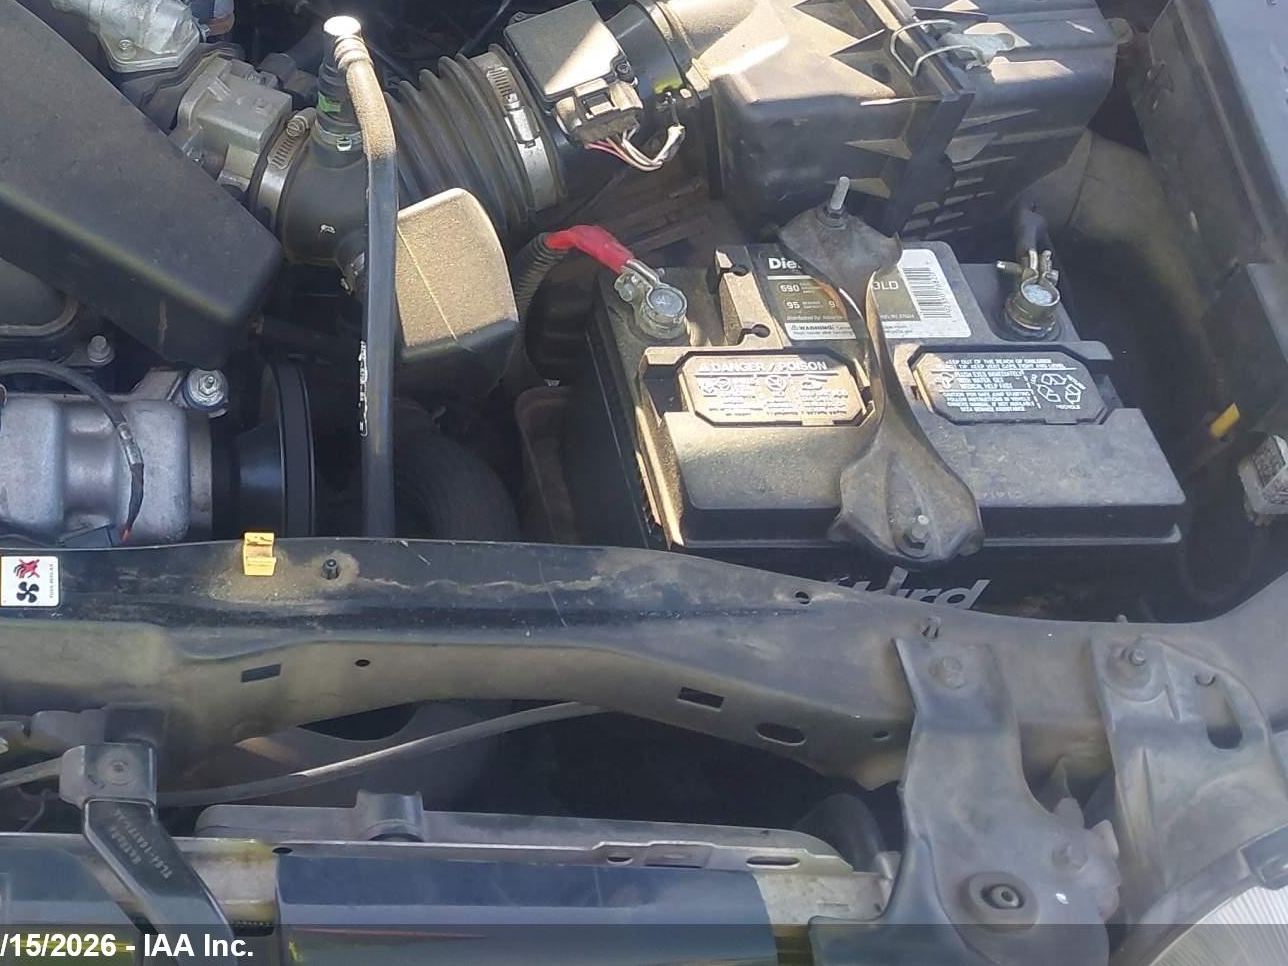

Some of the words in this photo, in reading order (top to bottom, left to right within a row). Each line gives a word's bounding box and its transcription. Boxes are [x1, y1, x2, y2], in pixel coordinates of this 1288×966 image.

[786, 301, 800, 309] 95
[712, 361, 766, 372] DANGER
[779, 361, 828, 371] POISON
